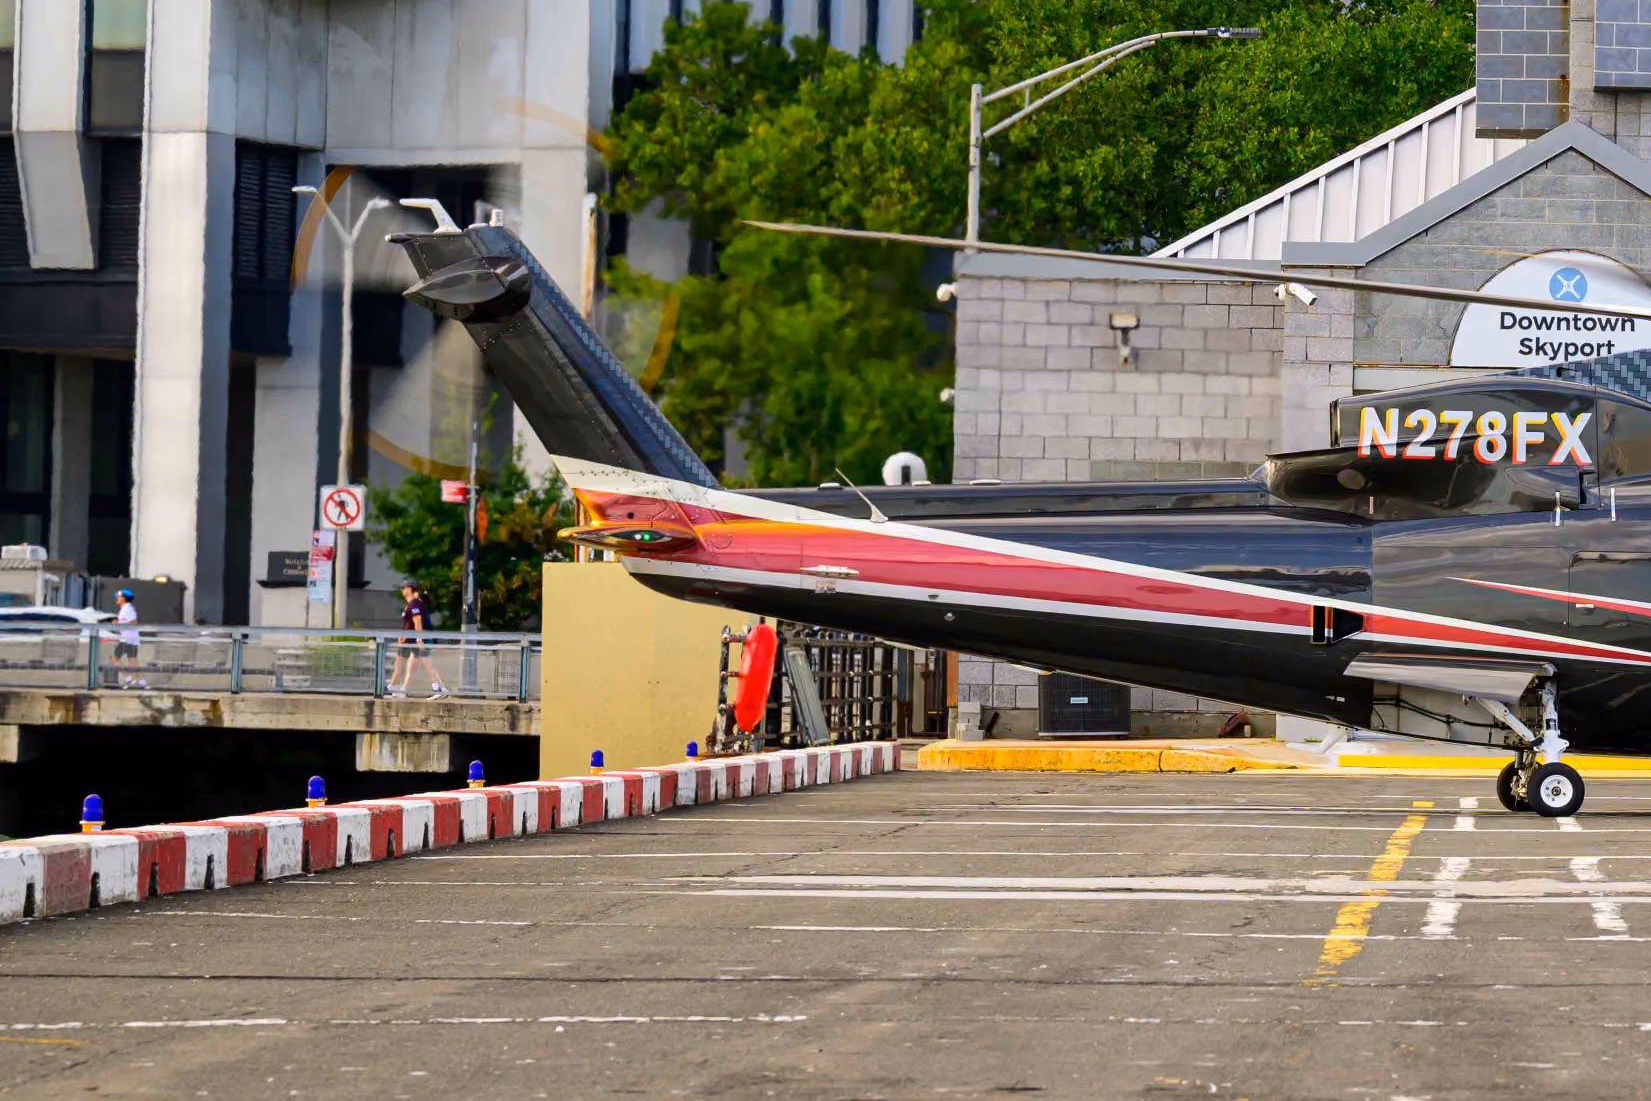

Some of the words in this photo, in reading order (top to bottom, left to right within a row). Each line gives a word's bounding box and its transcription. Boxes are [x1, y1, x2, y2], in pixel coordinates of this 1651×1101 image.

[1500, 311, 1636, 333] Downtown
[1518, 337, 1616, 362] Skyport
[1357, 406, 1594, 466] N278FX
